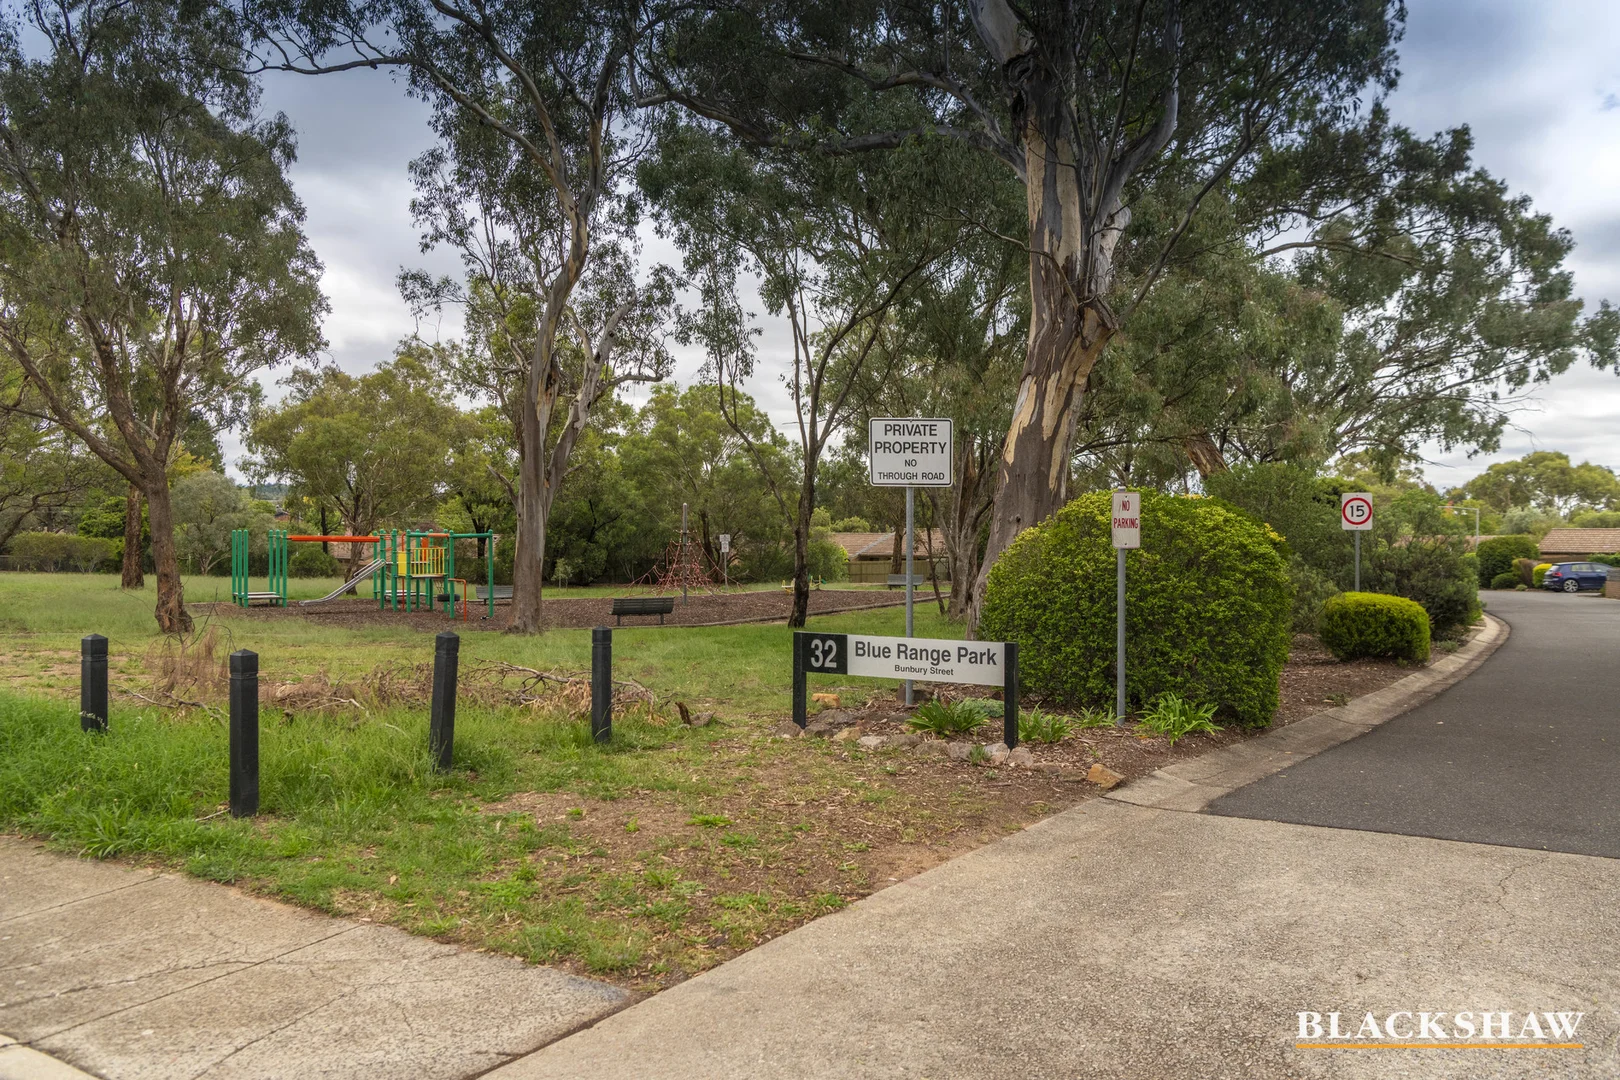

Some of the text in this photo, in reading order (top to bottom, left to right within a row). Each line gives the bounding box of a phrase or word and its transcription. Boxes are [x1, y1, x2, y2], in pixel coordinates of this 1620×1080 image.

[884, 424, 937, 436] PRIVATE
[874, 441, 947, 454] PROPERTY
[904, 459, 917, 467] NO
[878, 472, 945, 480] THROUGH ROAD
[1121, 500, 1131, 511] NO
[1350, 505, 1365, 517] 15
[1113, 518, 1138, 528] PARKING
[810, 639, 837, 668] 32
[854, 641, 997, 666] Blue Range Park
[894, 664, 954, 675] Bunbury Street
